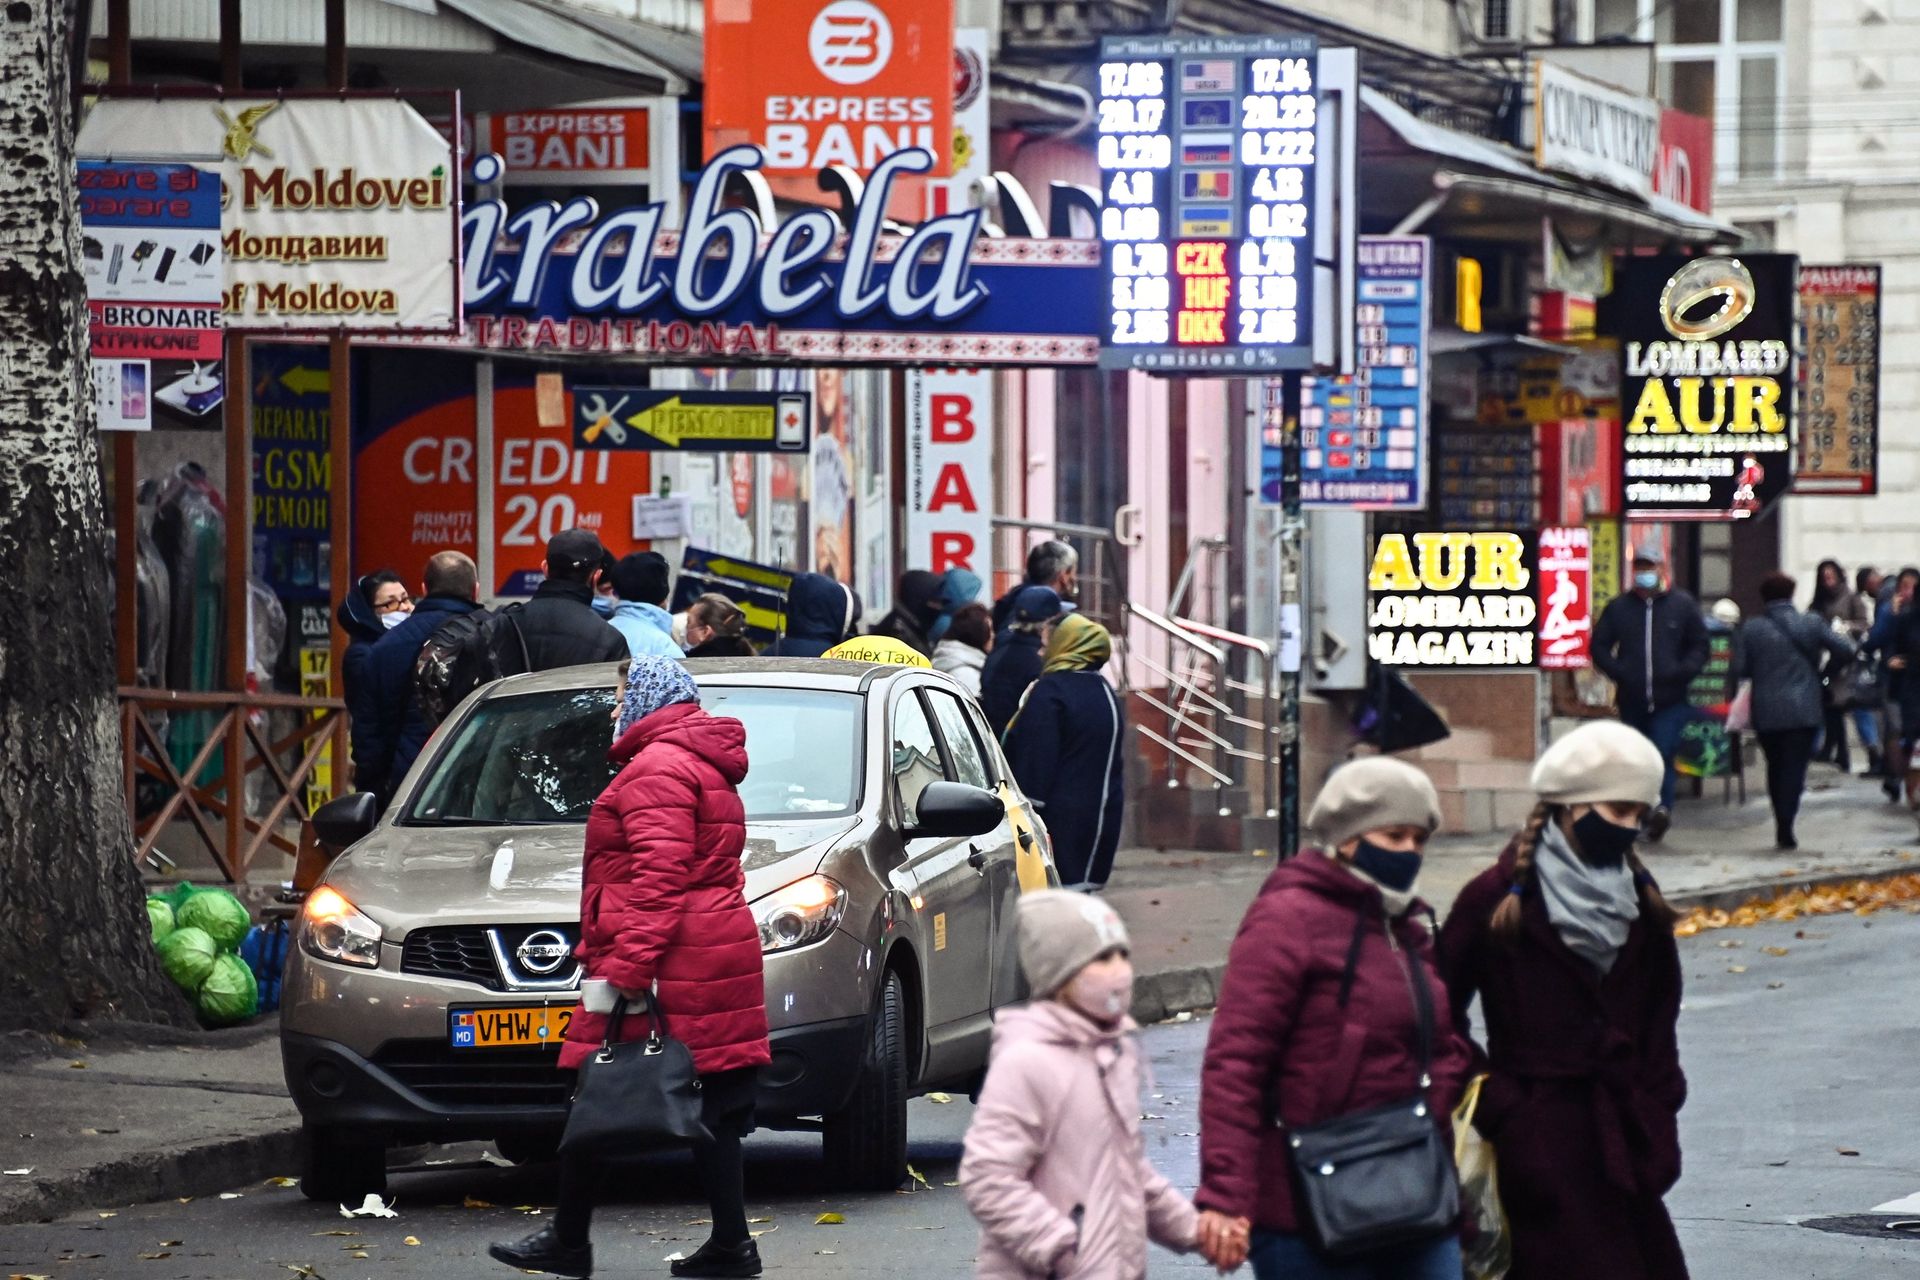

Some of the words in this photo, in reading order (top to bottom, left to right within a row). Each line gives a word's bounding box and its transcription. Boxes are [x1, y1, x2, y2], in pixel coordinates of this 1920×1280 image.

[504, 115, 625, 134] EXPRESS
[765, 96, 933, 122] EXPRESS
[504, 135, 626, 168] BANI
[765, 124, 933, 169] BANI
[241, 164, 445, 210] Moldovei
[221, 229, 388, 264] Молдавии
[1176, 243, 1227, 275] CZK
[256, 283, 398, 314] Moldova
[1185, 276, 1230, 309] HUF
[104, 307, 220, 328] BRONARE
[1178, 310, 1226, 342] DKK
[469, 315, 789, 356] TRADITIONAL
[1133, 349, 1235, 367] comision
[1625, 340, 1788, 376] LOMBARD
[1626, 376, 1786, 433] AUR
[265, 448, 332, 492] GSM
[926, 368, 979, 576] BAR
[453, 529, 472, 544] LA
[502, 494, 577, 547] 20
[1369, 533, 1530, 591] AUR
[828, 646, 880, 662] Yandex
[886, 650, 920, 667] Taxi
[1369, 631, 1534, 664] MAGAZIN
[521, 947, 564, 956] NISSAN
[456, 1030, 471, 1043] MD
[477, 1012, 531, 1042] VHW
